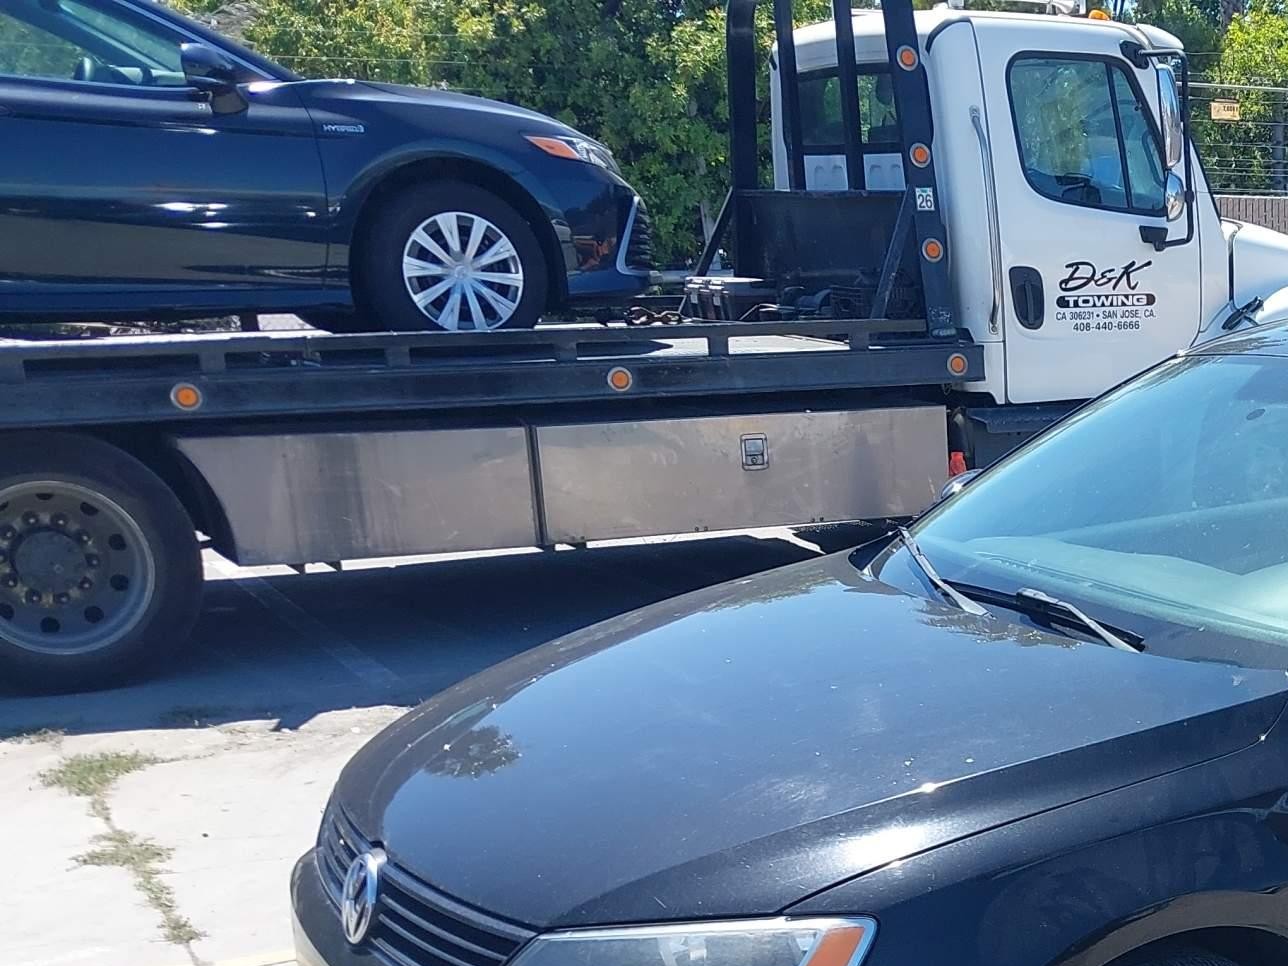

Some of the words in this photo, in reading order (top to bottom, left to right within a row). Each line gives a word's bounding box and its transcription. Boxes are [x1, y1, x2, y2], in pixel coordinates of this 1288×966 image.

[917, 193, 932, 209] 26
[1059, 260, 1153, 292] D&K
[1064, 294, 1147, 308] TOWING
[1056, 311, 1067, 321] CA
[1069, 310, 1095, 321] 306231
[1101, 310, 1118, 320] SAN
[1073, 320, 1140, 332] 408-440-6666
